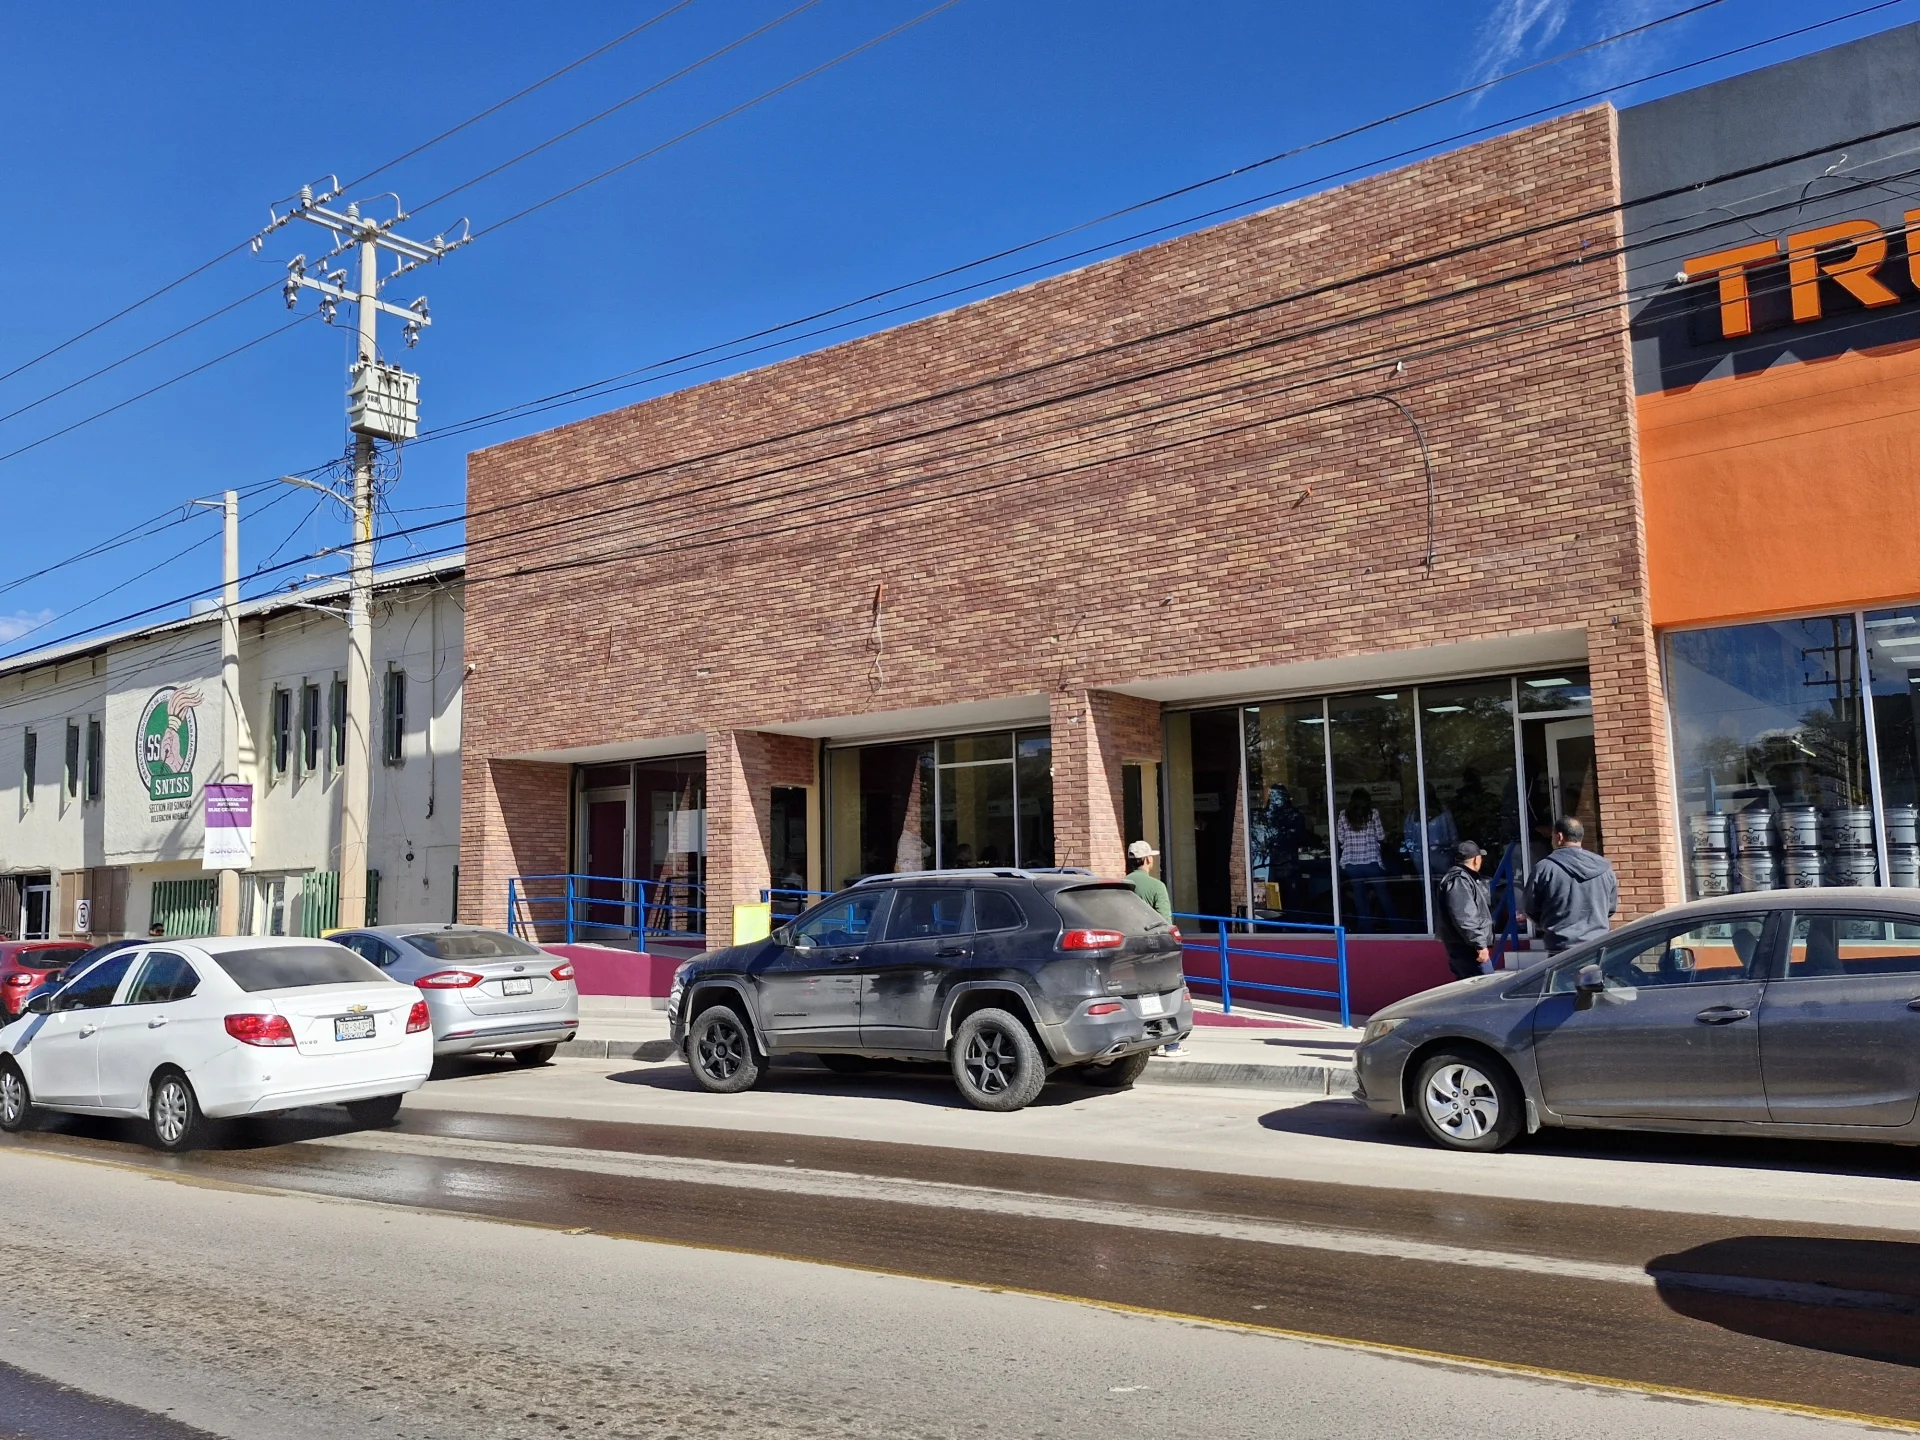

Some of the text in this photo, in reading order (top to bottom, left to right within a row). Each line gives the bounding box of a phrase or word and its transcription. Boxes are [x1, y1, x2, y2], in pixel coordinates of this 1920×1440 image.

[146, 734, 161, 761] SS
[183, 715, 194, 771] TRABAJADORES
[155, 777, 190, 796] SNTSS
[174, 800, 192, 811] SONORA
[1742, 834, 1760, 842] Osel
[1703, 879, 1722, 887] Osel
[1794, 878, 1814, 886] Osel
